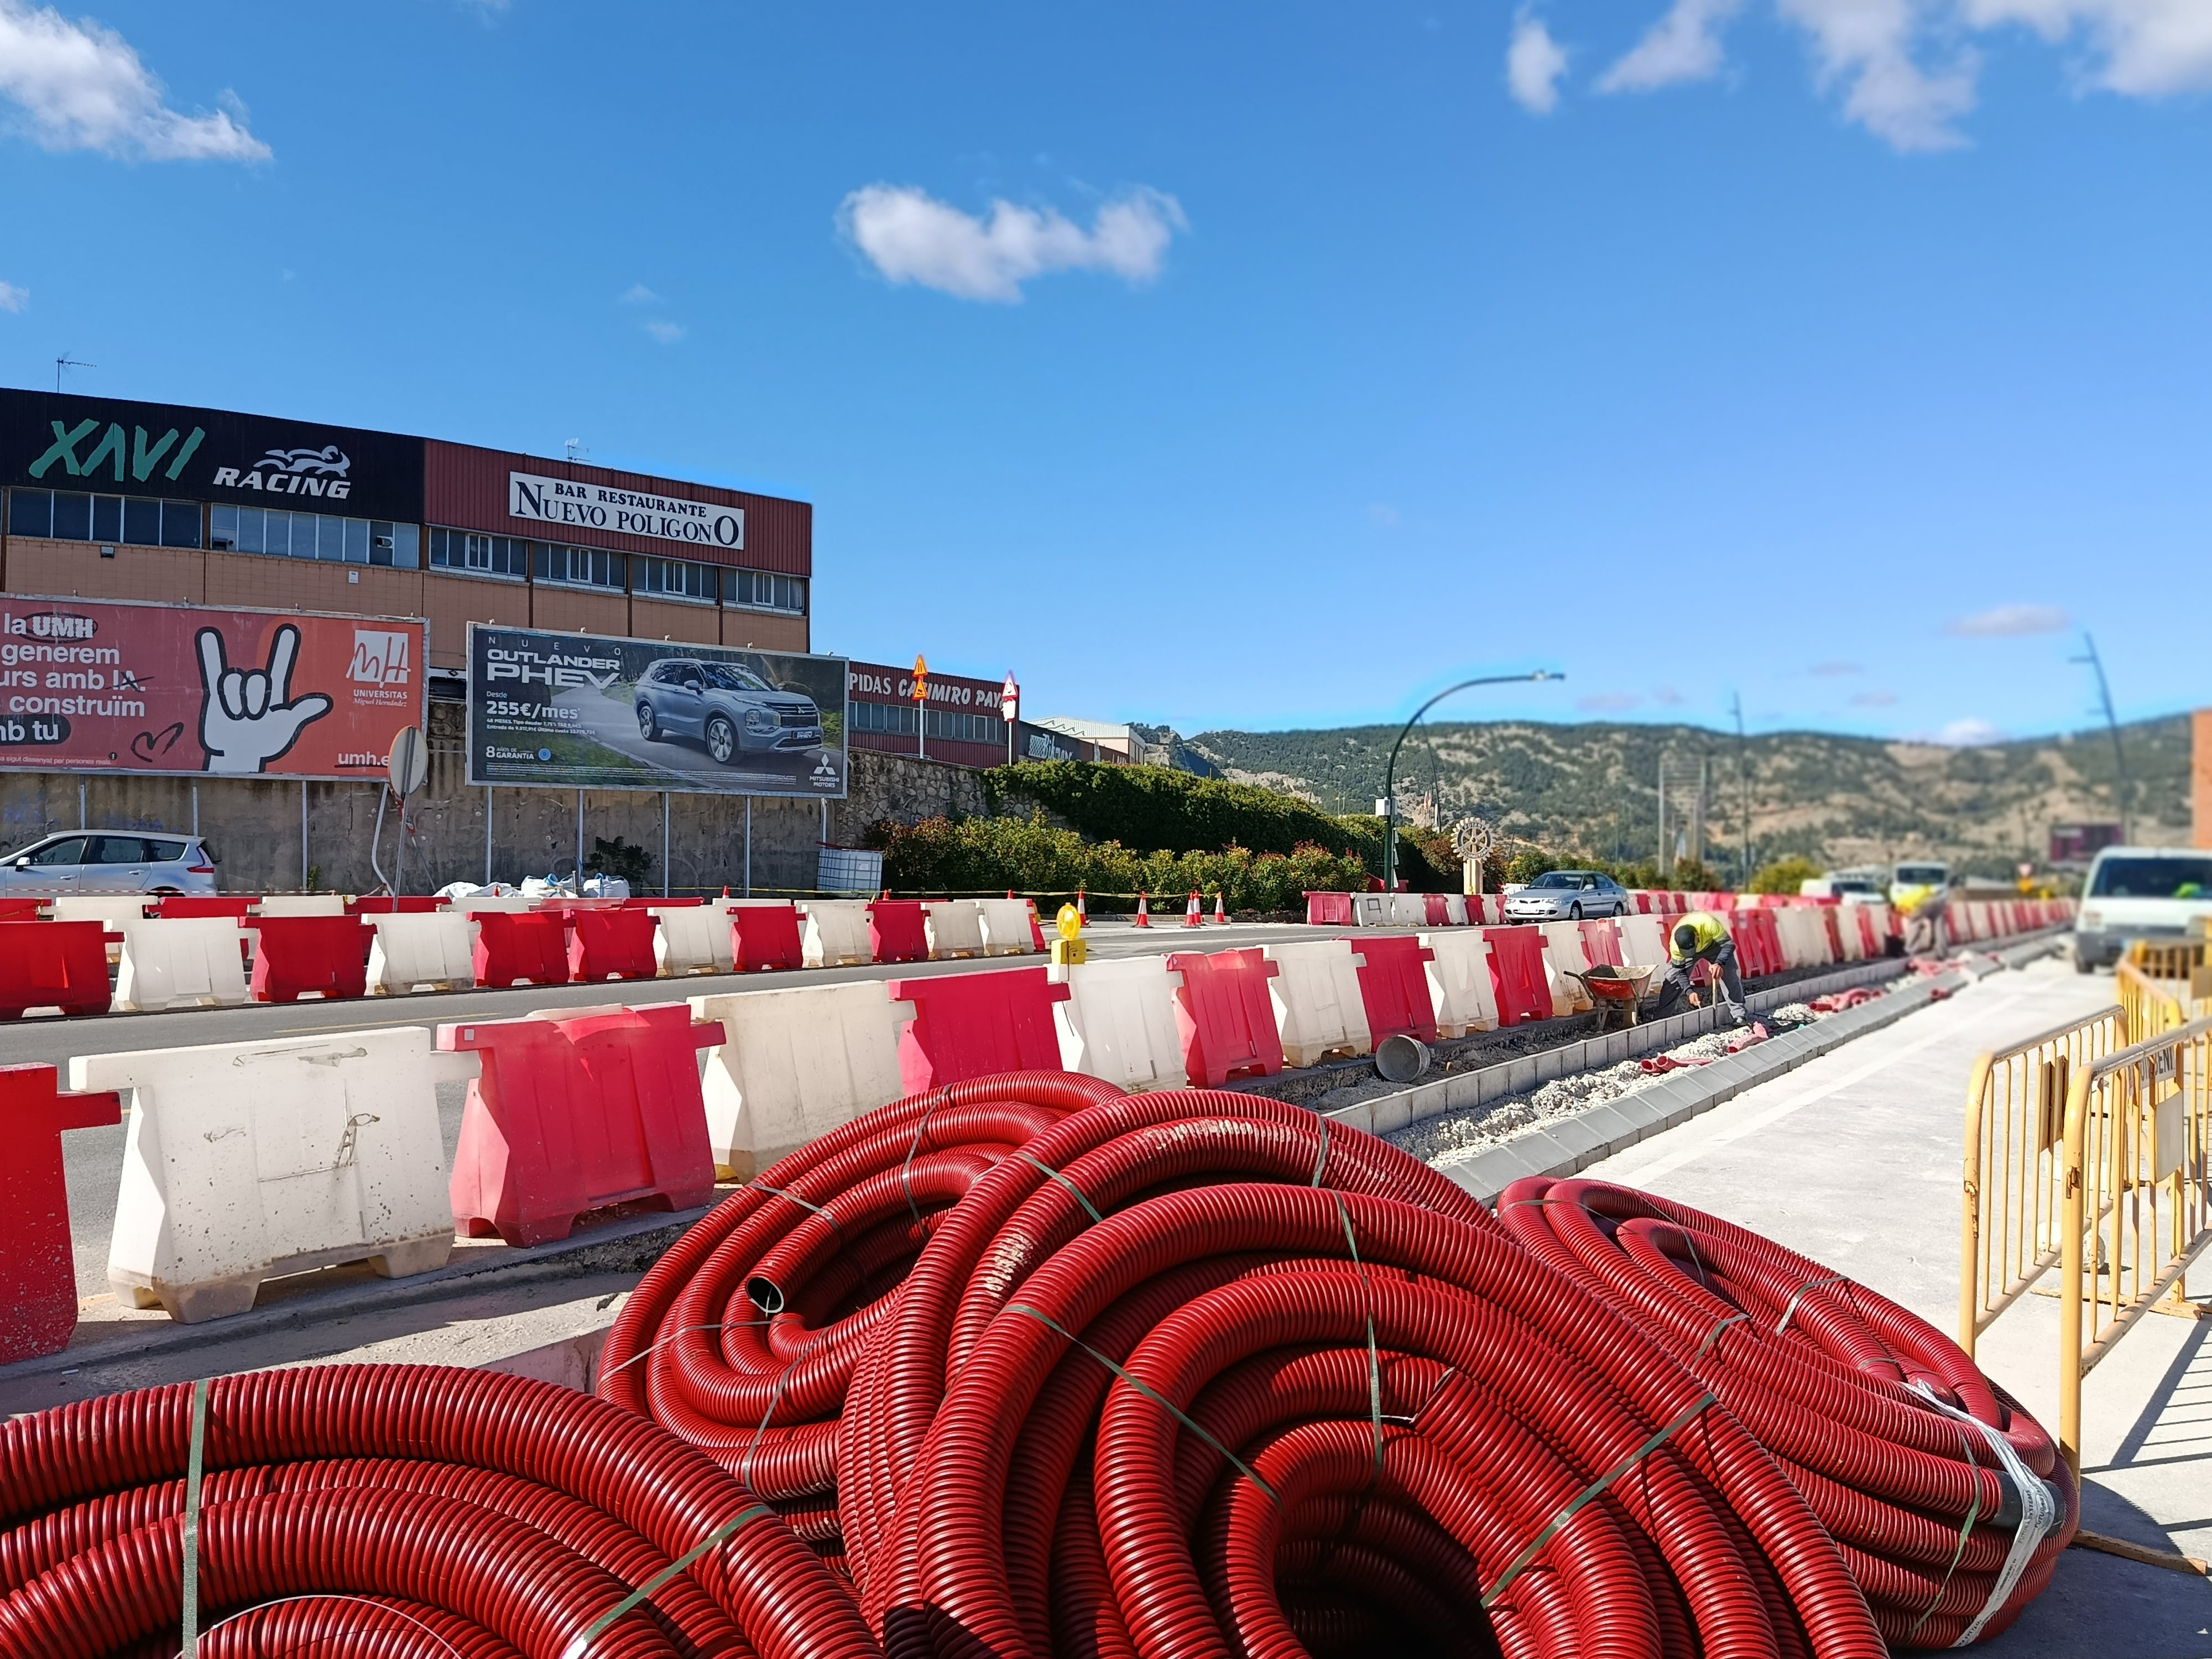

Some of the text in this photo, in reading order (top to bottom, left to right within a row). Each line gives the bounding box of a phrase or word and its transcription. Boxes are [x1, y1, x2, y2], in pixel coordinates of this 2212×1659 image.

[29, 418, 205, 482] XAVI
[212, 467, 351, 499] RACING
[555, 483, 707, 518] BAR RESTAURANTE
[515, 481, 739, 546] NUEVO POLIGONO
[4, 613, 93, 638] la UMH
[1, 644, 119, 666] generem
[489, 637, 621, 655] NUEVO
[487, 649, 620, 670] OUTLANDER
[45, 669, 105, 690] amb
[487, 662, 620, 690] PHEV
[353, 689, 408, 700] UNIVERSITAS
[353, 697, 374, 706] Miguel
[486, 691, 508, 699] Desde
[898, 678, 971, 706] CAIMIRO
[9, 695, 145, 717] construïm
[32, 721, 59, 740] tu
[486, 745, 495, 758] 8
